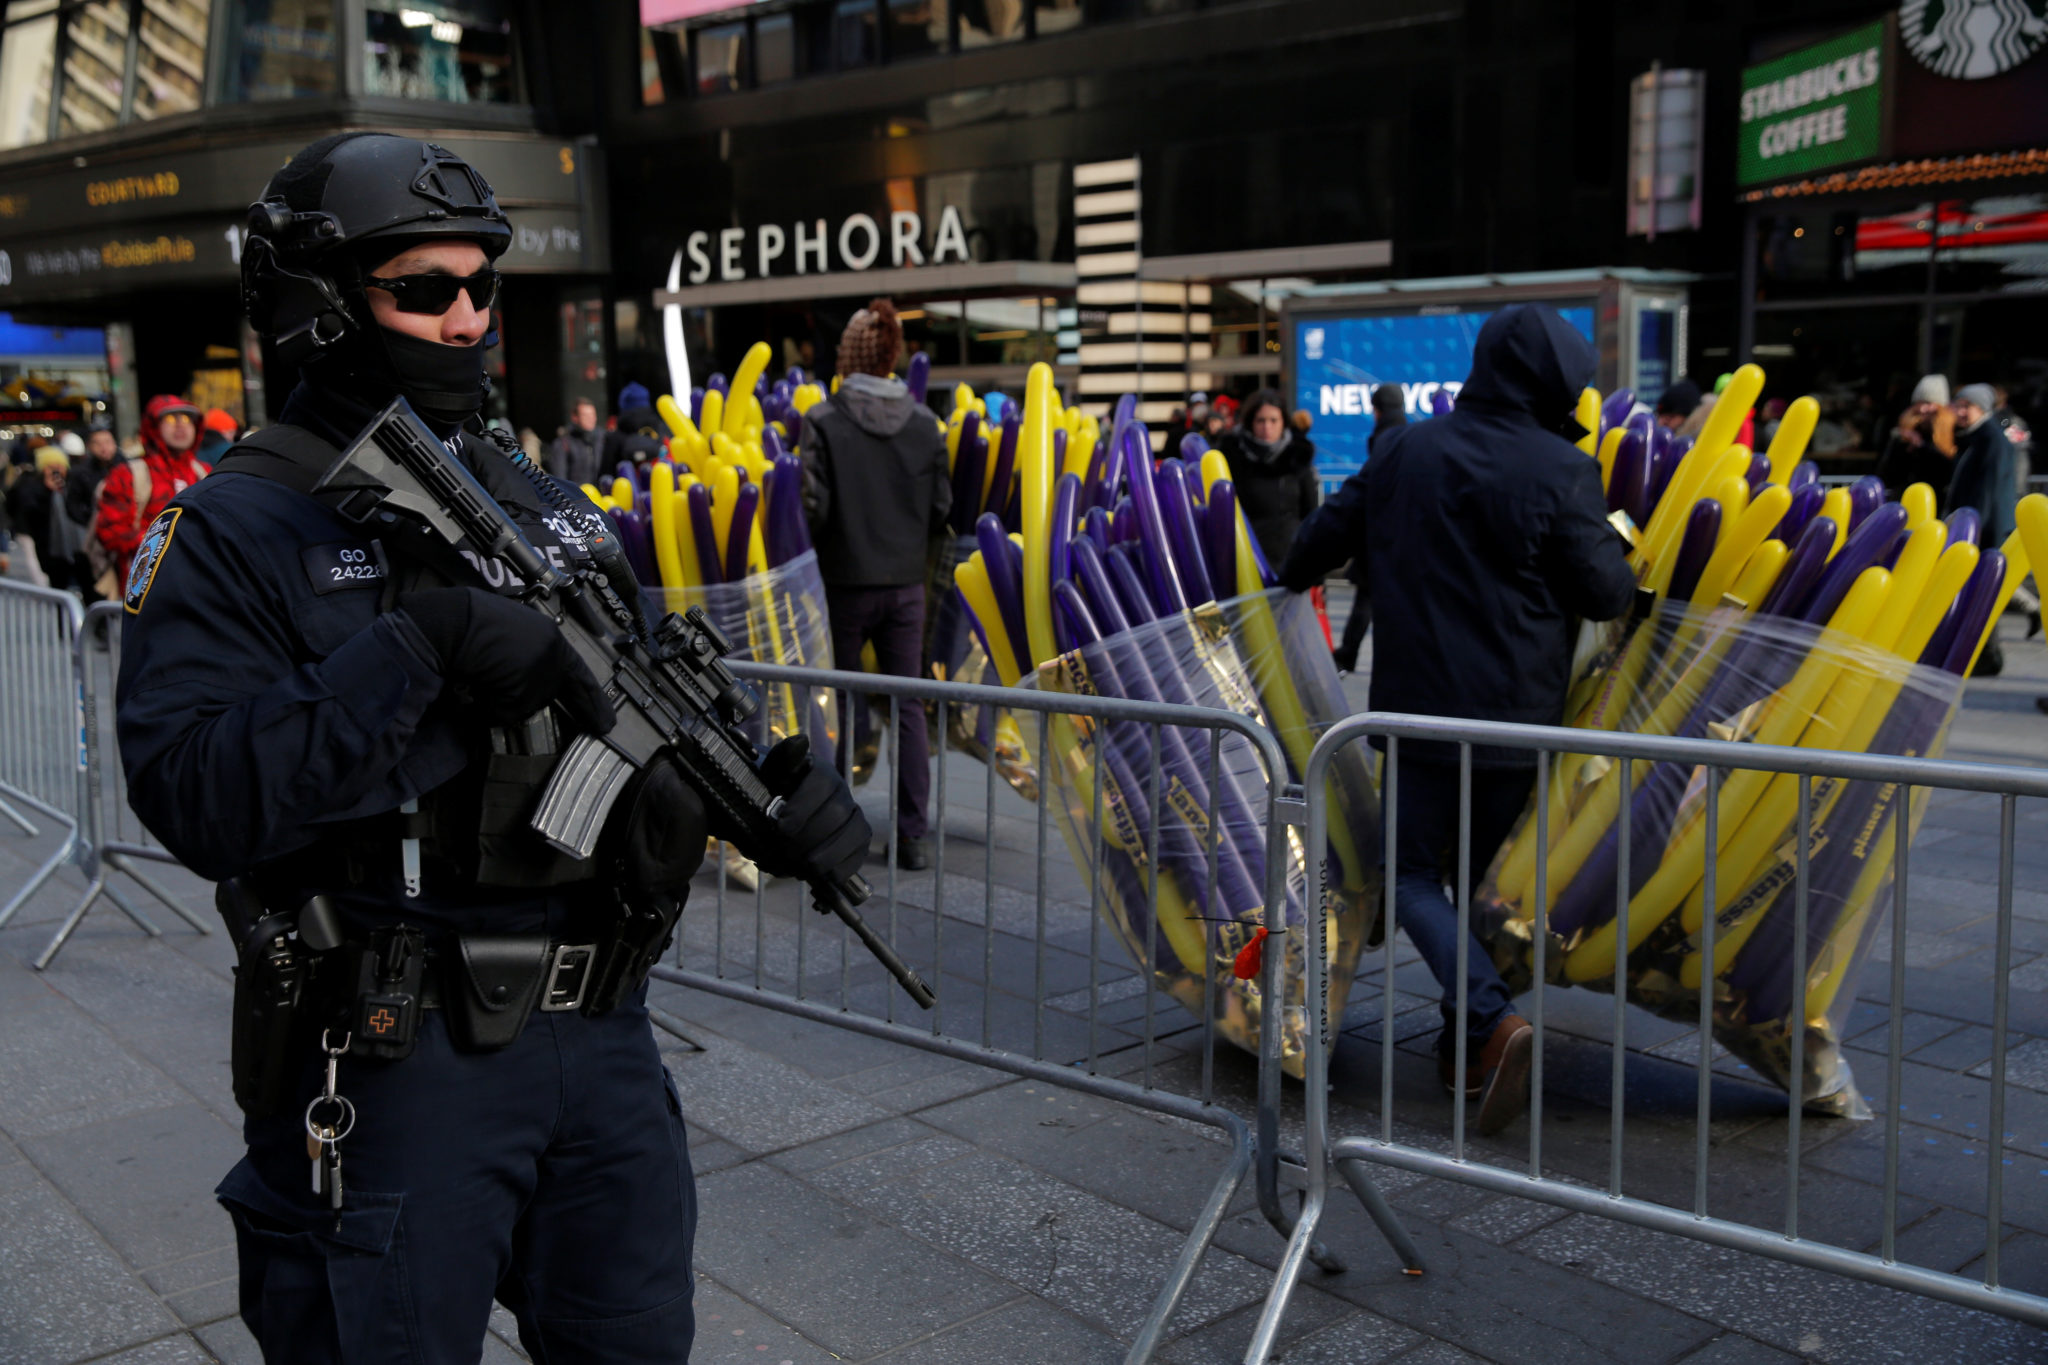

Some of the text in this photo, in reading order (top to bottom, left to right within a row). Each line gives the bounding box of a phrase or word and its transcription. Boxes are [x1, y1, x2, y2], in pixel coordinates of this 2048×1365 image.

[1741, 47, 1879, 124] STARBUCKS
[1759, 103, 1847, 159] COFFEE
[86, 171, 180, 206] COURTYARD
[518, 225, 549, 256] by
[687, 205, 970, 285] SEPHORA
[340, 549, 366, 563] GO
[1852, 803, 1886, 860] planet
[1717, 860, 1795, 929] fitness
